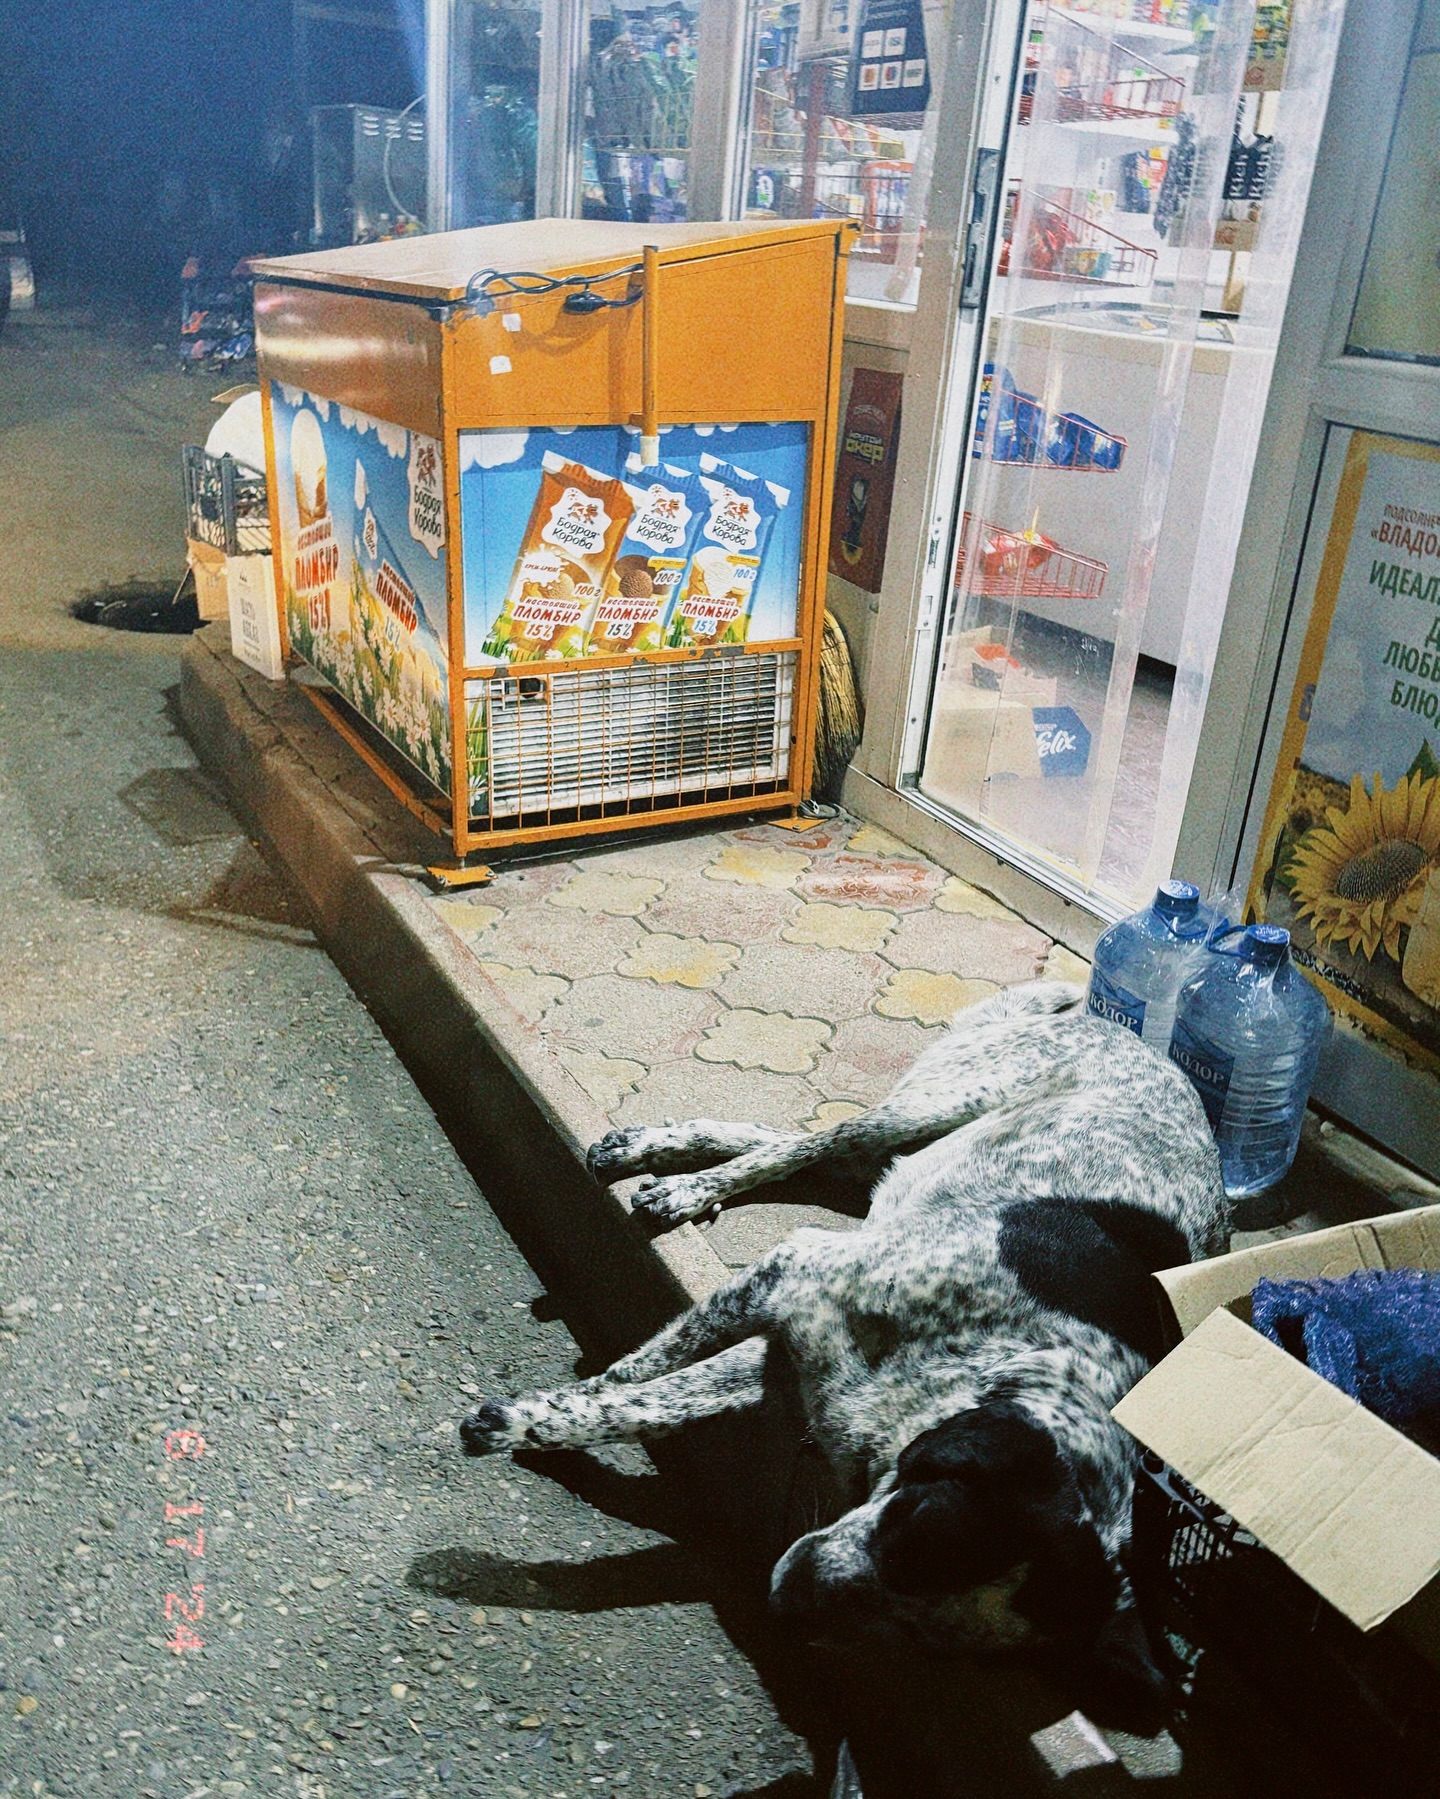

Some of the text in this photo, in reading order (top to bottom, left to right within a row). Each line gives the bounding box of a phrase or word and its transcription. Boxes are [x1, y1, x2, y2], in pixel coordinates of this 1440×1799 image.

[414, 484, 442, 516] Бодрая
[414, 507, 442, 538] Корова
[556, 517, 599, 541] Бодрая
[640, 513, 680, 534] Бодрая
[715, 514, 751, 535] Бодрая
[552, 528, 593, 550] Корова
[636, 525, 674, 546] Корова
[711, 525, 746, 547] Корова
[1371, 521, 1440, 560] «ВЛАДО
[295, 544, 339, 592] ПЛОМБИР
[655, 572, 674, 583] 100
[733, 568, 750, 579] 100
[574, 584, 594, 597] 100
[1369, 558, 1440, 606] ИДЕАЛ
[310, 591, 327, 630] 15%
[376, 572, 418, 635] ПЛОМБИР
[525, 599, 579, 611] настоящий
[607, 597, 656, 608] настоящий
[682, 603, 739, 620] ПЛОМБИР
[692, 595, 735, 607] настоящий
[513, 606, 581, 624] ПЛОМБИР
[597, 605, 659, 621] ПЛОМБИР
[384, 615, 401, 652] 15%
[526, 624, 553, 639] 15%
[606, 623, 632, 638] 15%
[694, 620, 716, 634] 15%
[1389, 679, 1440, 730] БЛЮ
[1035, 730, 1076, 758] Felix
[1089, 994, 1138, 1031] КОДОР
[1171, 1042, 1225, 1085] КОДОР
